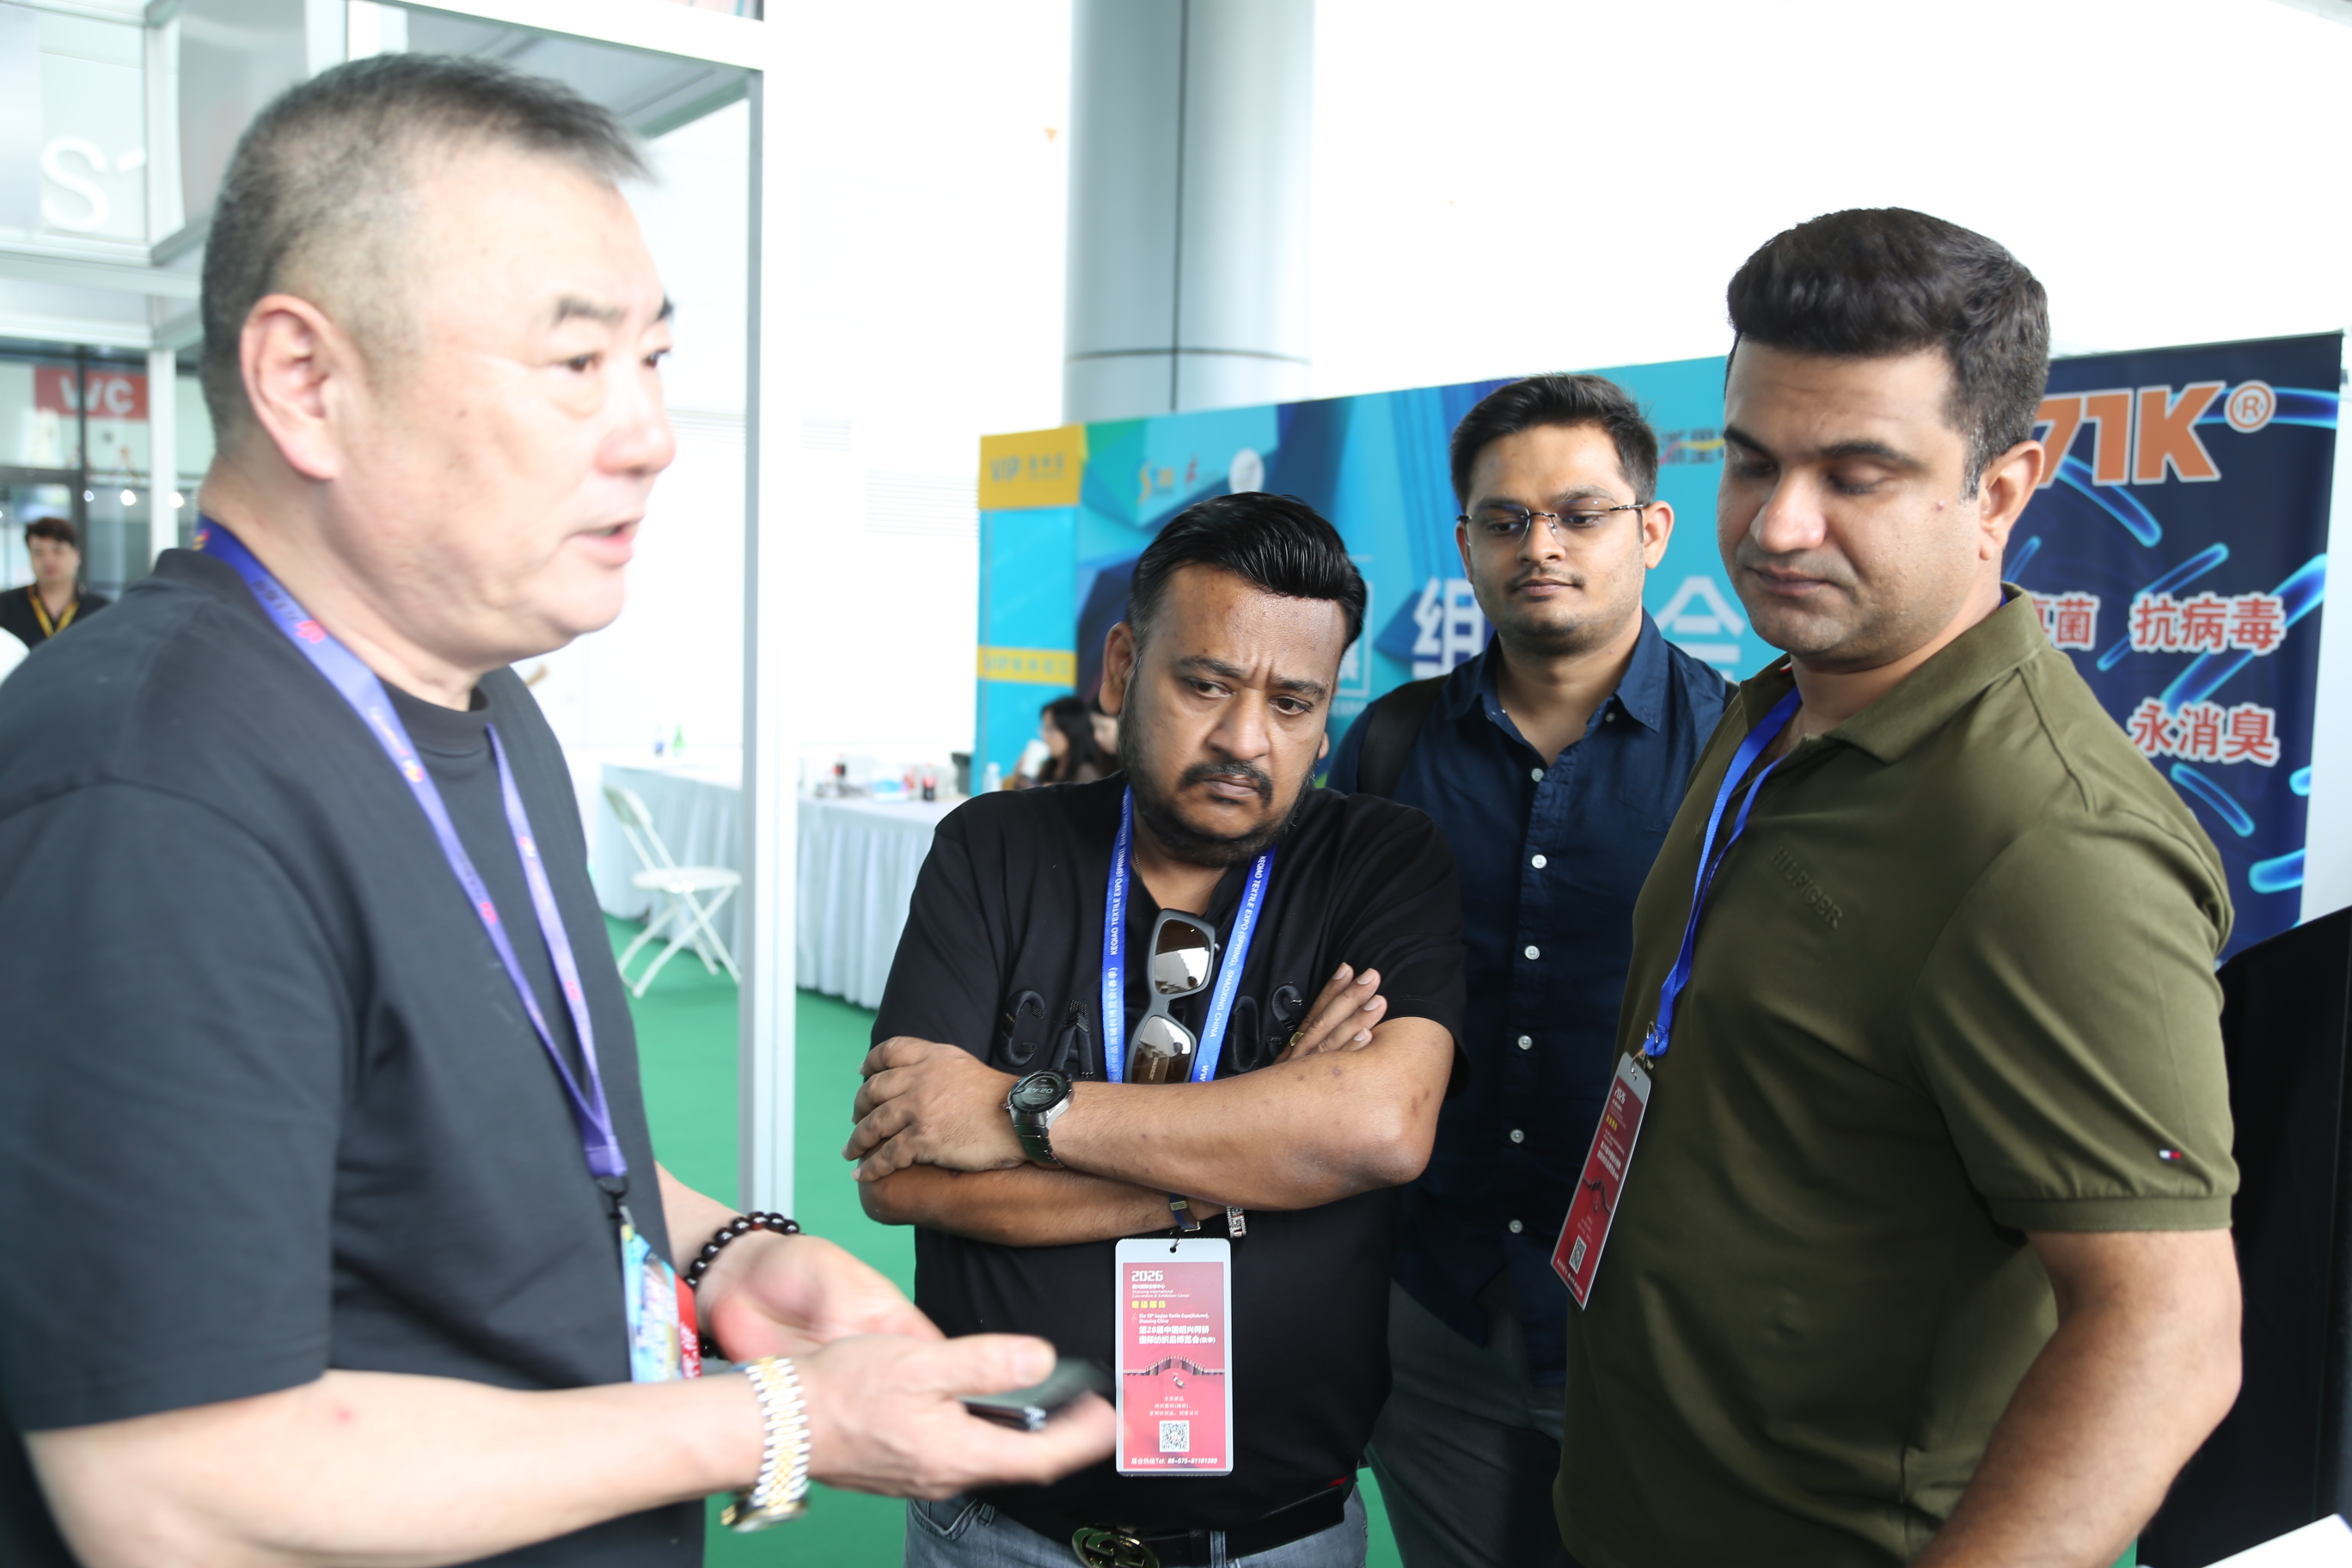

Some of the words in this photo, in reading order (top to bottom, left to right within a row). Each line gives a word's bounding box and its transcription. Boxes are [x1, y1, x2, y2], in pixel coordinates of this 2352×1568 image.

[59, 374, 134, 414] WC
[2128, 591, 2286, 654] 抗病毒
[2128, 701, 2282, 767] 永消臭
[1254, 855, 1267, 879] KEQIAO
[1113, 878, 1124, 897] EXPO
[1246, 879, 1261, 909] TEXTILE
[1769, 845, 1843, 930] HILFIGER
[1111, 897, 1122, 927] TEXTILE
[1240, 908, 1255, 931] EXPO
[1110, 928, 1120, 956] KEQIAO
[1216, 968, 1236, 1011] SHAOXING
[1209, 1011, 1223, 1038] CHINA
[1131, 1271, 1164, 1282] 2026
[1139, 1325, 1210, 1334] 第28届中国绍兴柯桥
